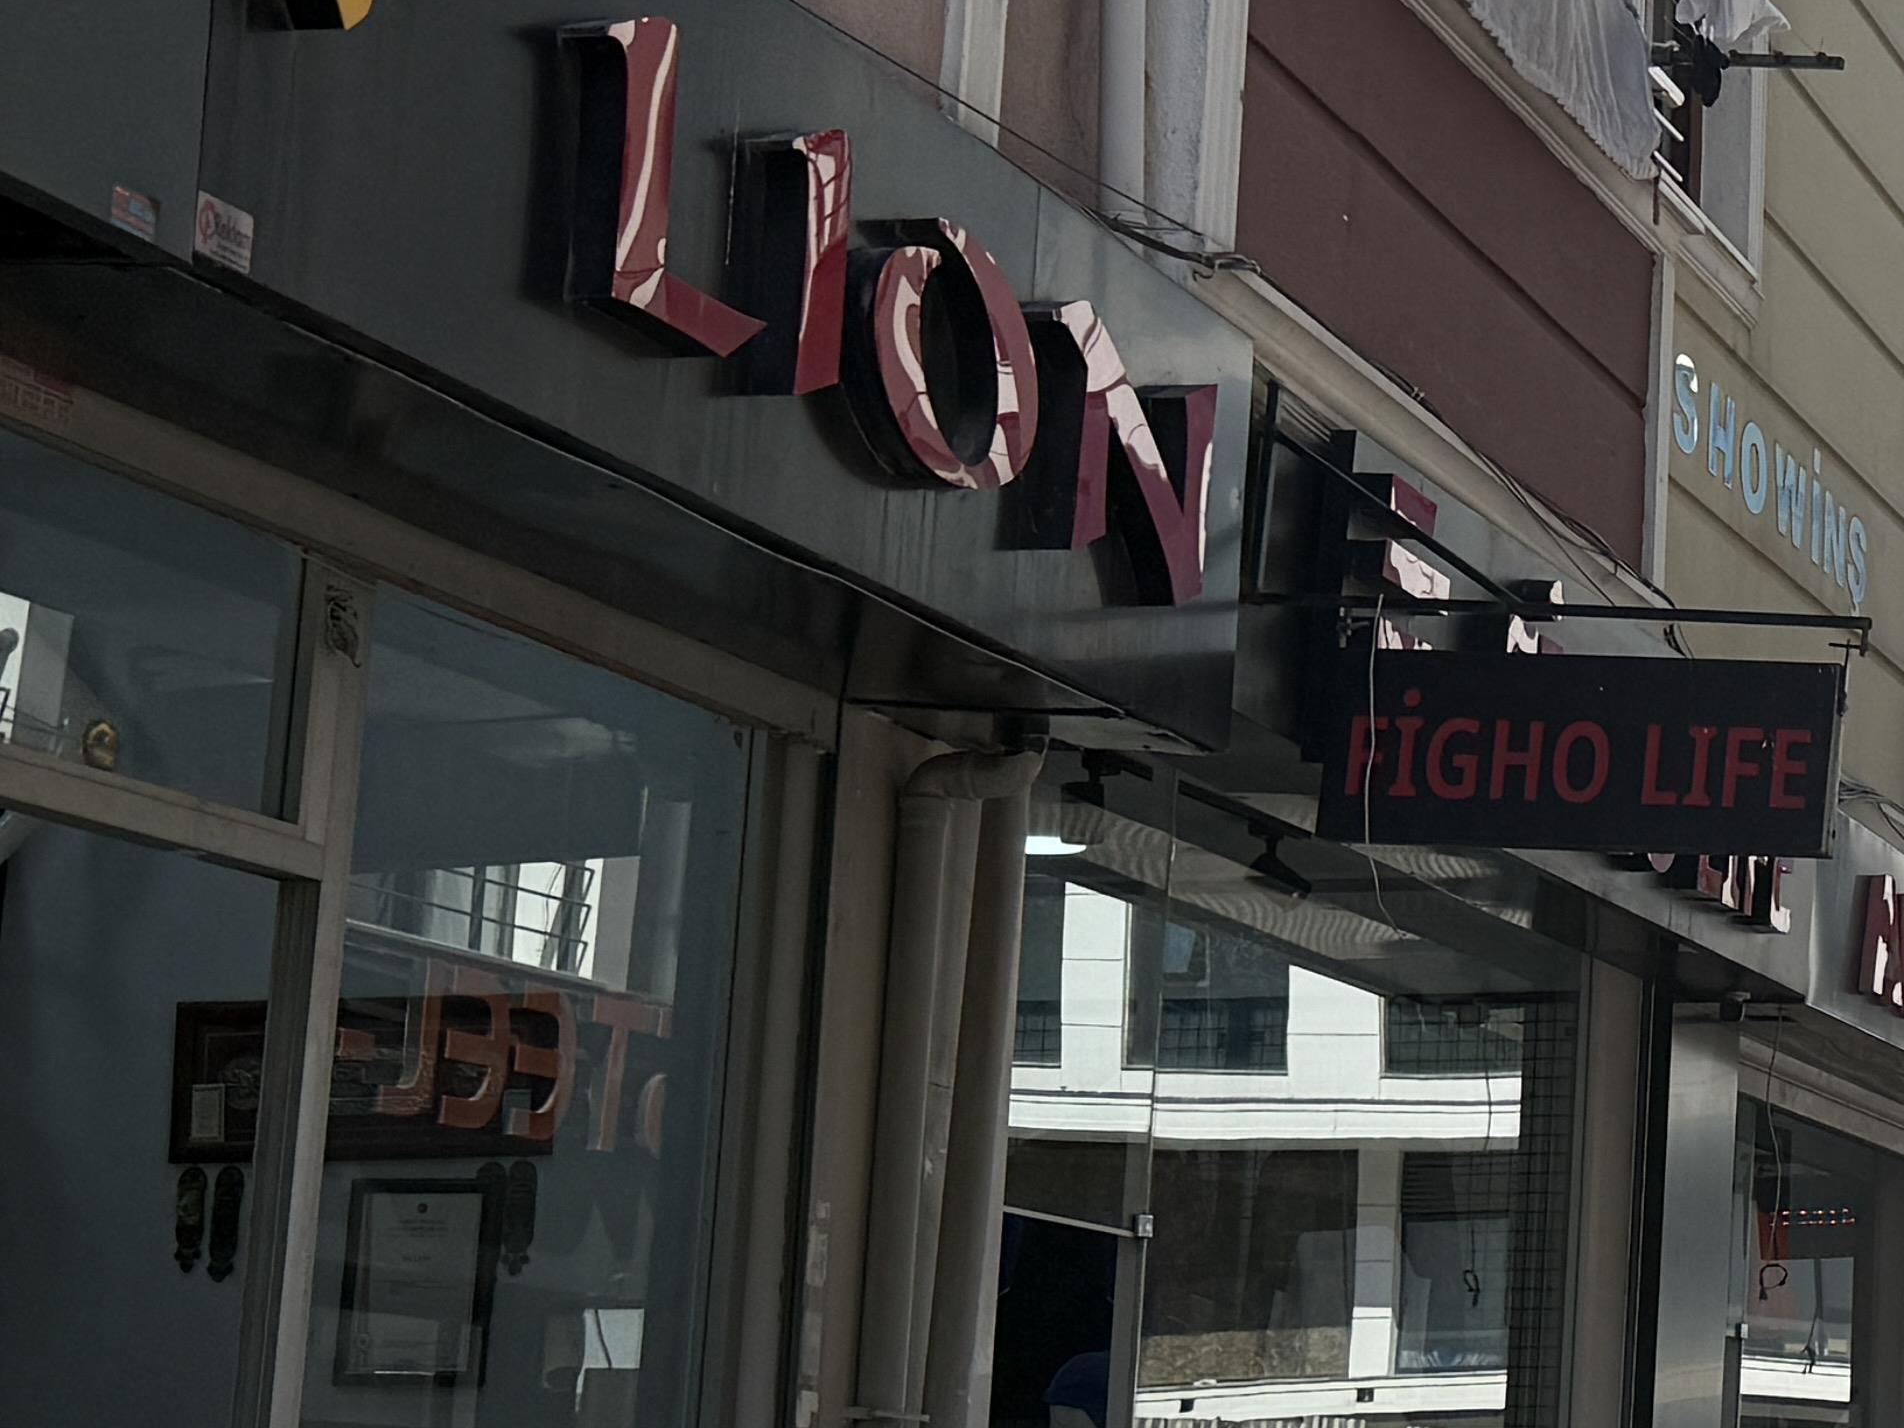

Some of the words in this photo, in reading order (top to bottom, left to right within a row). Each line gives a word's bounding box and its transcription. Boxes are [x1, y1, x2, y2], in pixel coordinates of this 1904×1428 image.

[607, 14, 1217, 607] LION
[1344, 687, 1610, 804] FİGHO
[1641, 724, 1812, 810] LIFE
